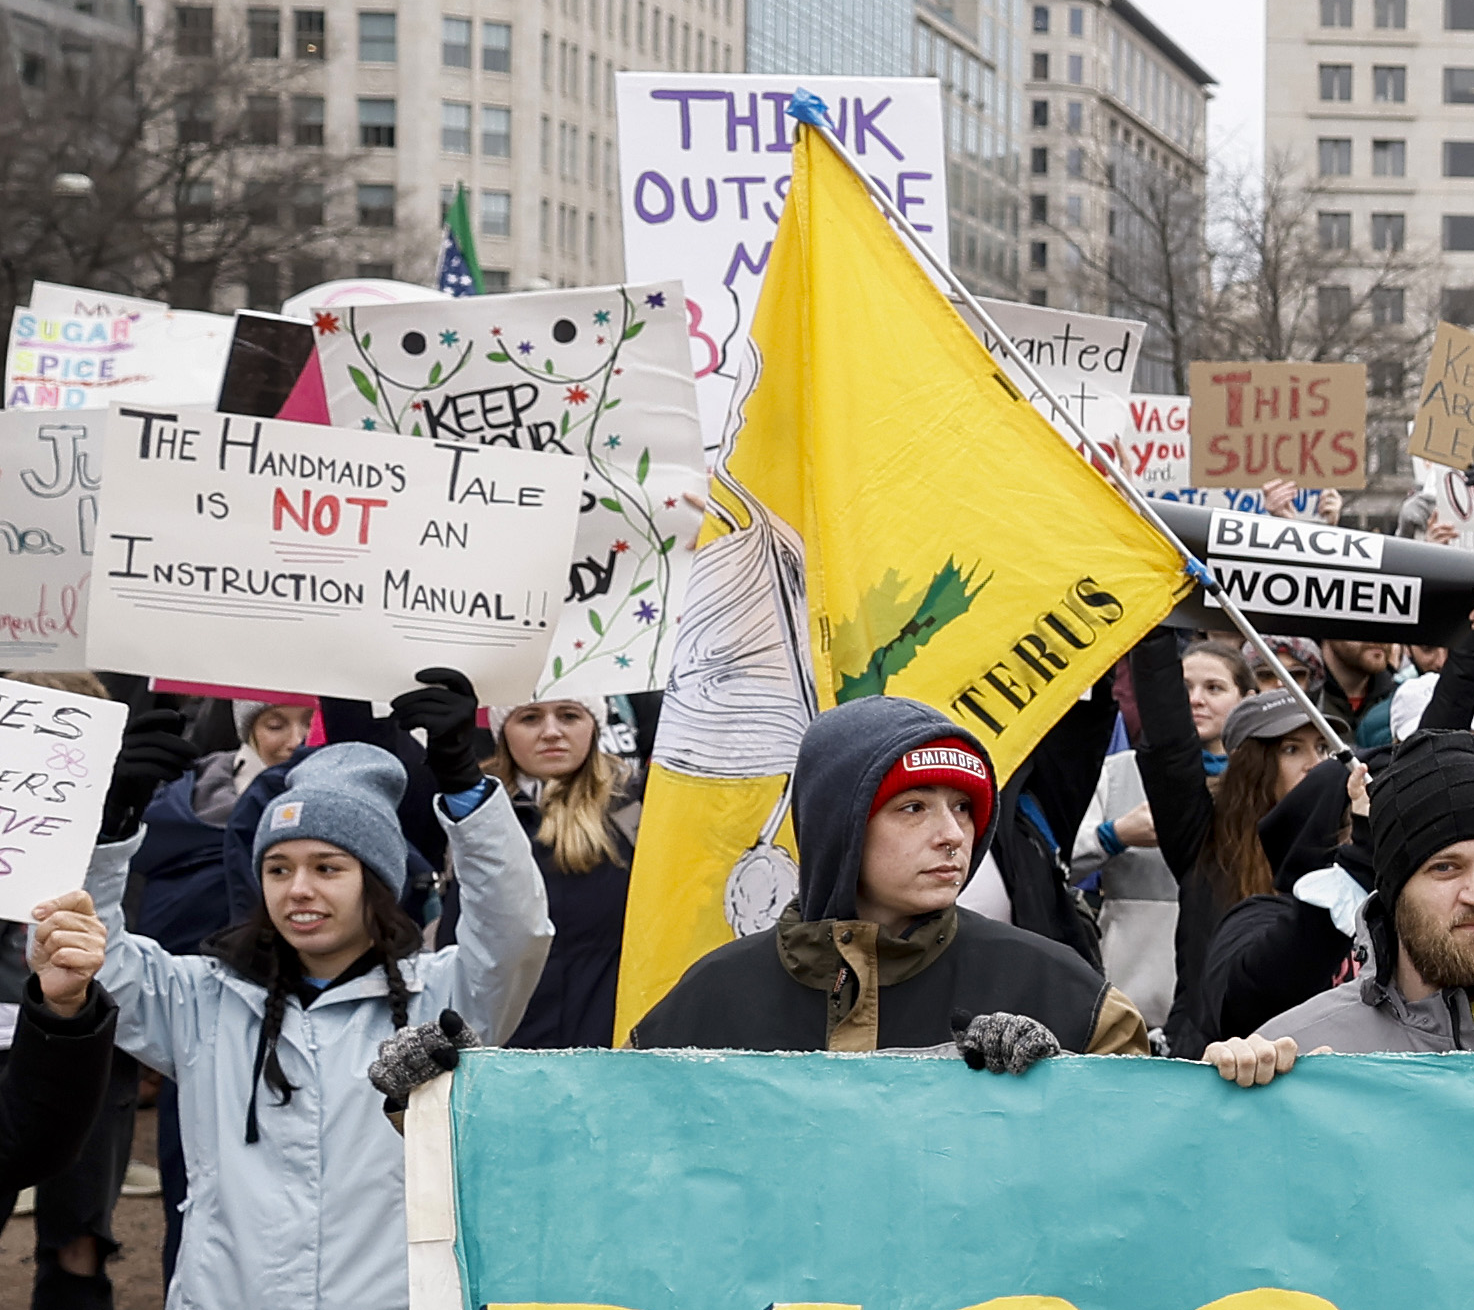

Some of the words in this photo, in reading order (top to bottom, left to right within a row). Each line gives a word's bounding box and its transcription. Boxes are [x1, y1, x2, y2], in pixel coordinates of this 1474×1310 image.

[17, 316, 131, 342] SUGAR
[14, 351, 116, 379] SPICE
[8, 384, 87, 409] AND
[424, 382, 539, 440] KEEP
[1130, 401, 1190, 433] VAG
[119, 407, 201, 460] THE
[434, 442, 546, 507] TALE
[1206, 430, 1359, 478] SUCKS
[196, 492, 229, 519] IS
[272, 487, 388, 545] NOT
[419, 520, 468, 549] AN
[1216, 518, 1373, 560] BLACK
[108, 534, 364, 605] INSTRUCTION
[1213, 567, 1412, 616] WOMEN
[950, 575, 1126, 739] TERUS
